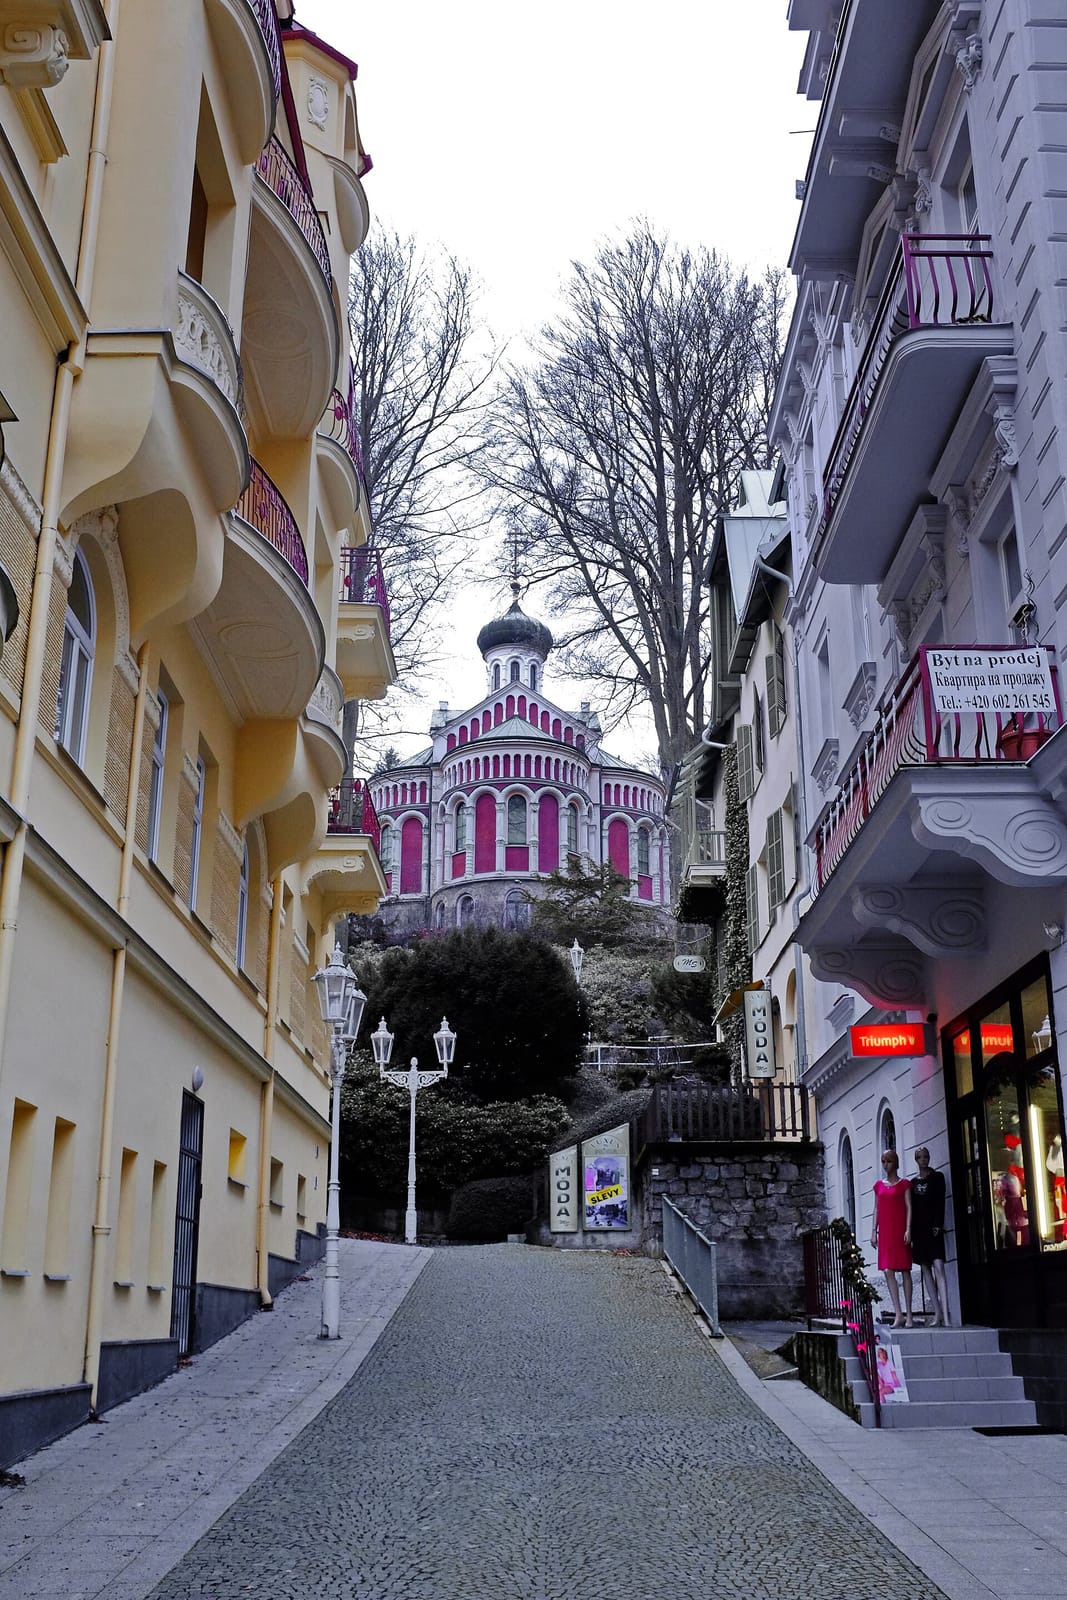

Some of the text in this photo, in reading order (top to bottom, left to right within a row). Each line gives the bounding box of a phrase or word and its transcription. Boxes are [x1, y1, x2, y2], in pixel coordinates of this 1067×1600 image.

[931, 651, 1041, 670] Byt na prodej
[934, 671, 1046, 690] Квартира на продажу
[938, 693, 1051, 710] Tel.: +420 602 261 545
[858, 1034, 907, 1049] Triumph
[590, 1187, 619, 1204] SLEVY
